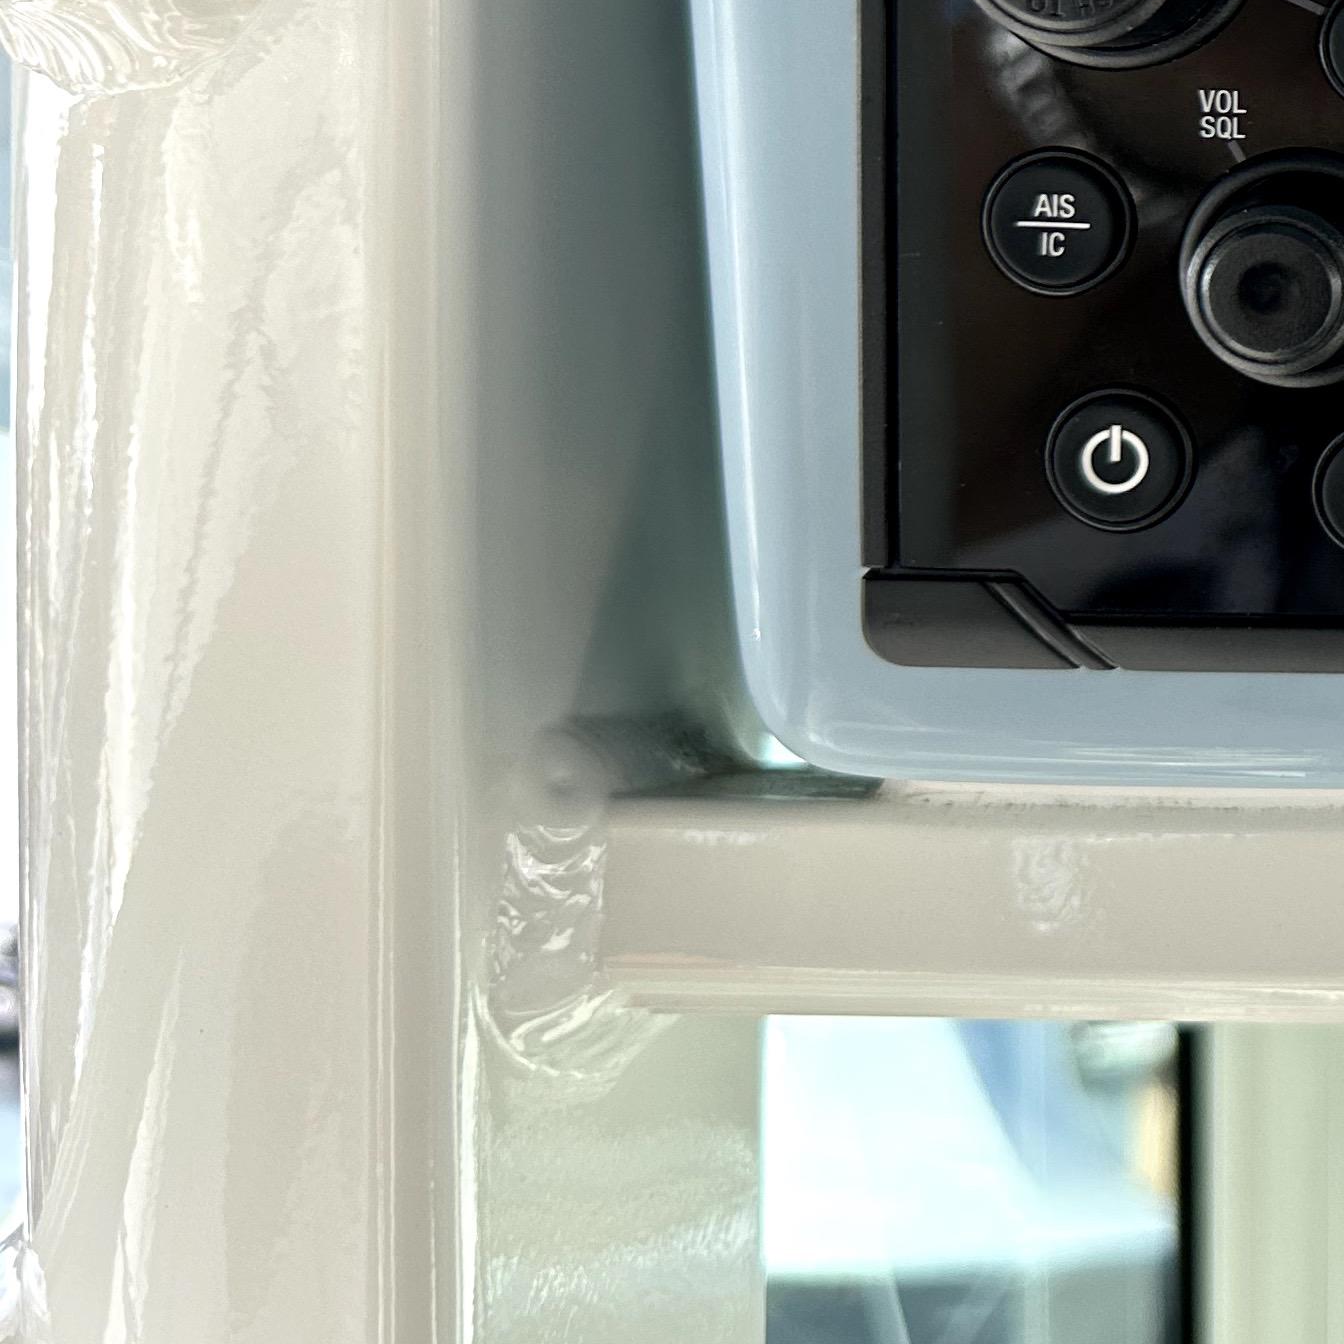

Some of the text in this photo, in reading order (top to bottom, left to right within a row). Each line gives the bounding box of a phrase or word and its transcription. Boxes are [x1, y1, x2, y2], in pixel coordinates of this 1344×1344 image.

[1198, 89, 1247, 114] VOL
[1200, 115, 1246, 140] SQL
[1033, 193, 1076, 219] AIS
[1040, 231, 1066, 257] IC
